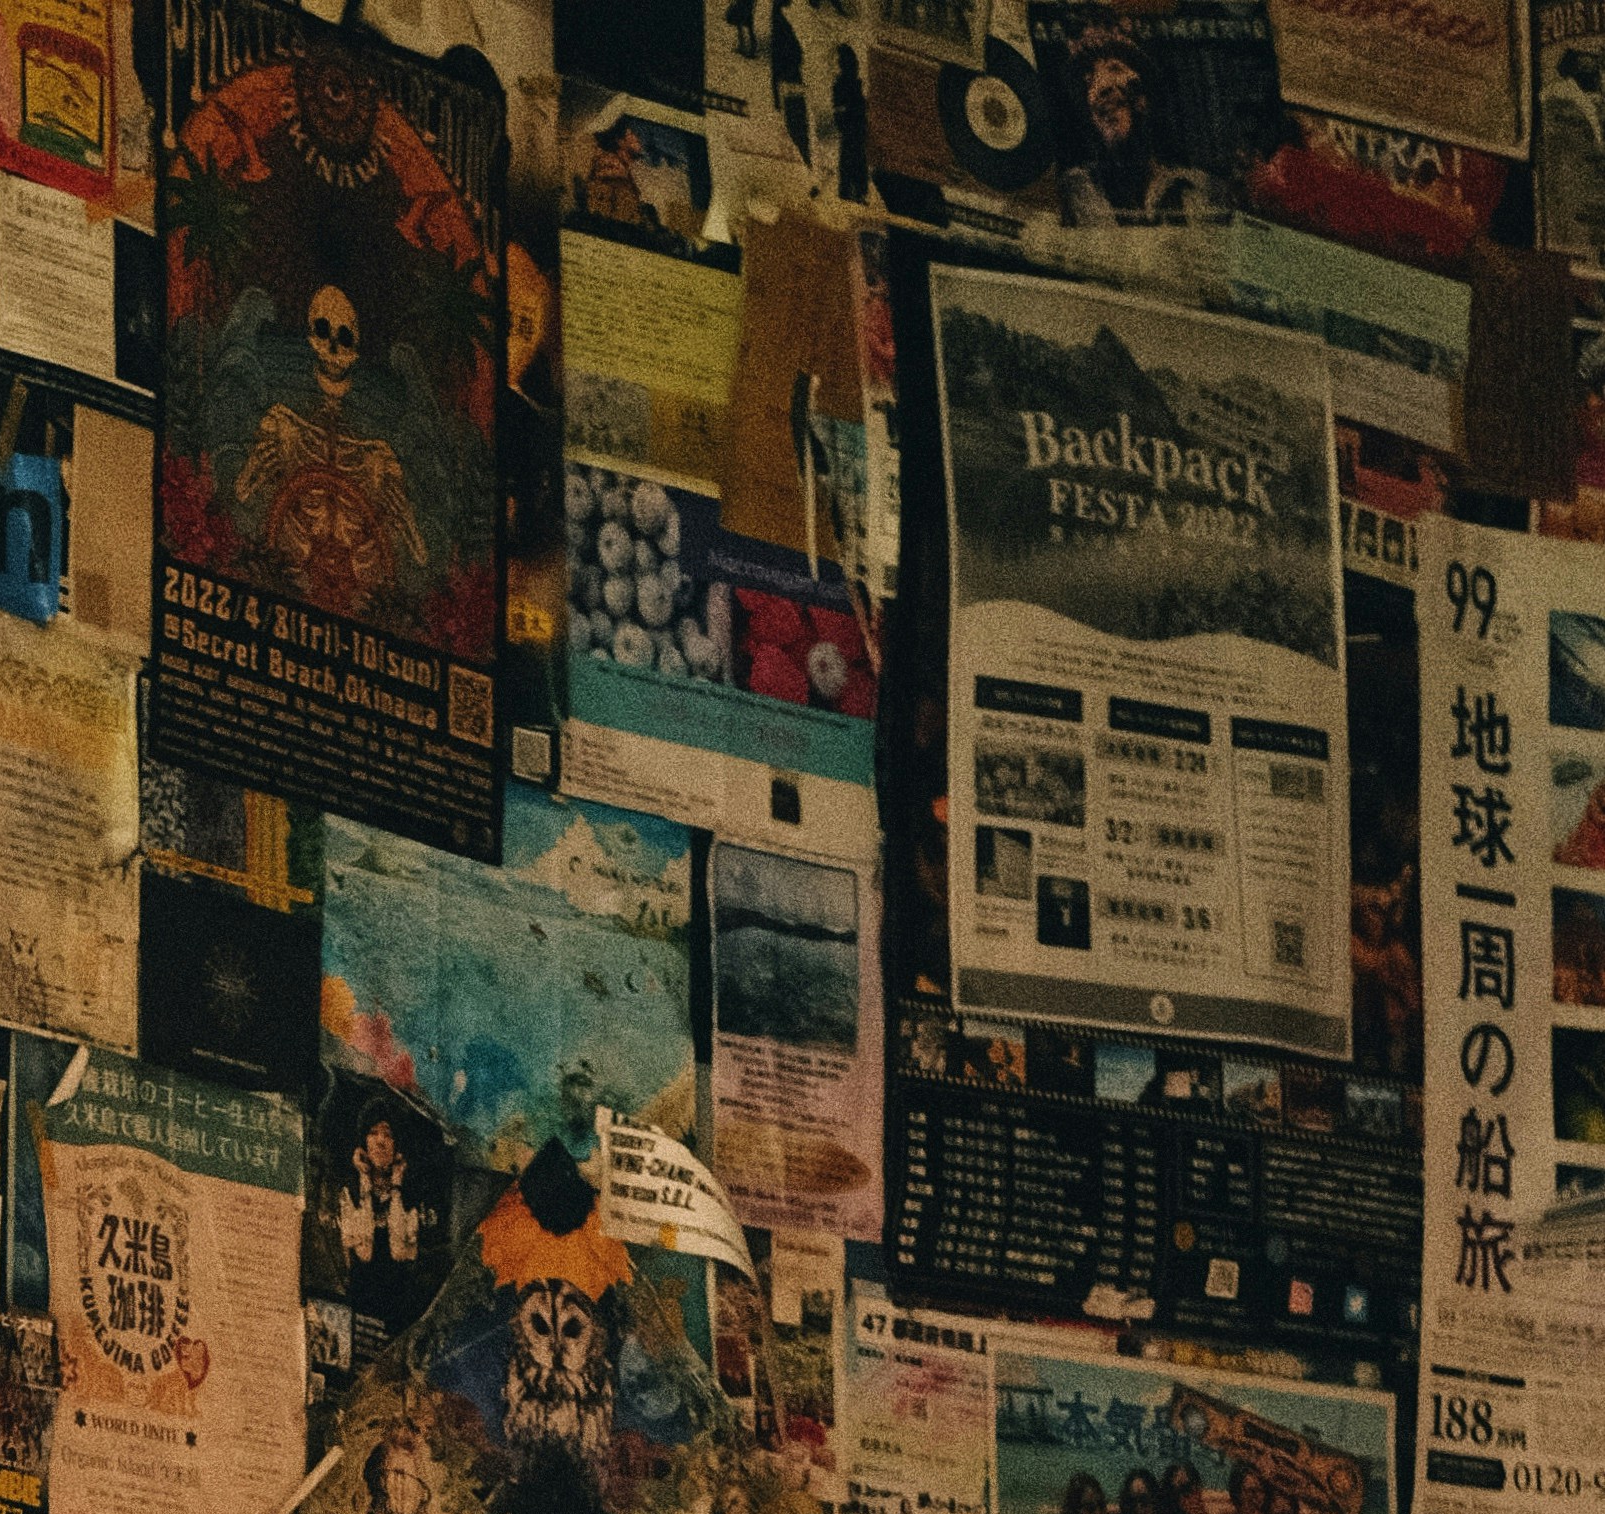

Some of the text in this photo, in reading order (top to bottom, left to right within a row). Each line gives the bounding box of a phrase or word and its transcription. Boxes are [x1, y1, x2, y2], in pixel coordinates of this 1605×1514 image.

[1021, 408, 1276, 512] Backpack
[1049, 477, 1172, 533] FESTA
[1446, 560, 1498, 640] 99
[1449, 686, 1519, 1295] 地球一周の船旅
[97, 1214, 174, 1281] 久米島
[107, 1274, 166, 1338] 珈琲
